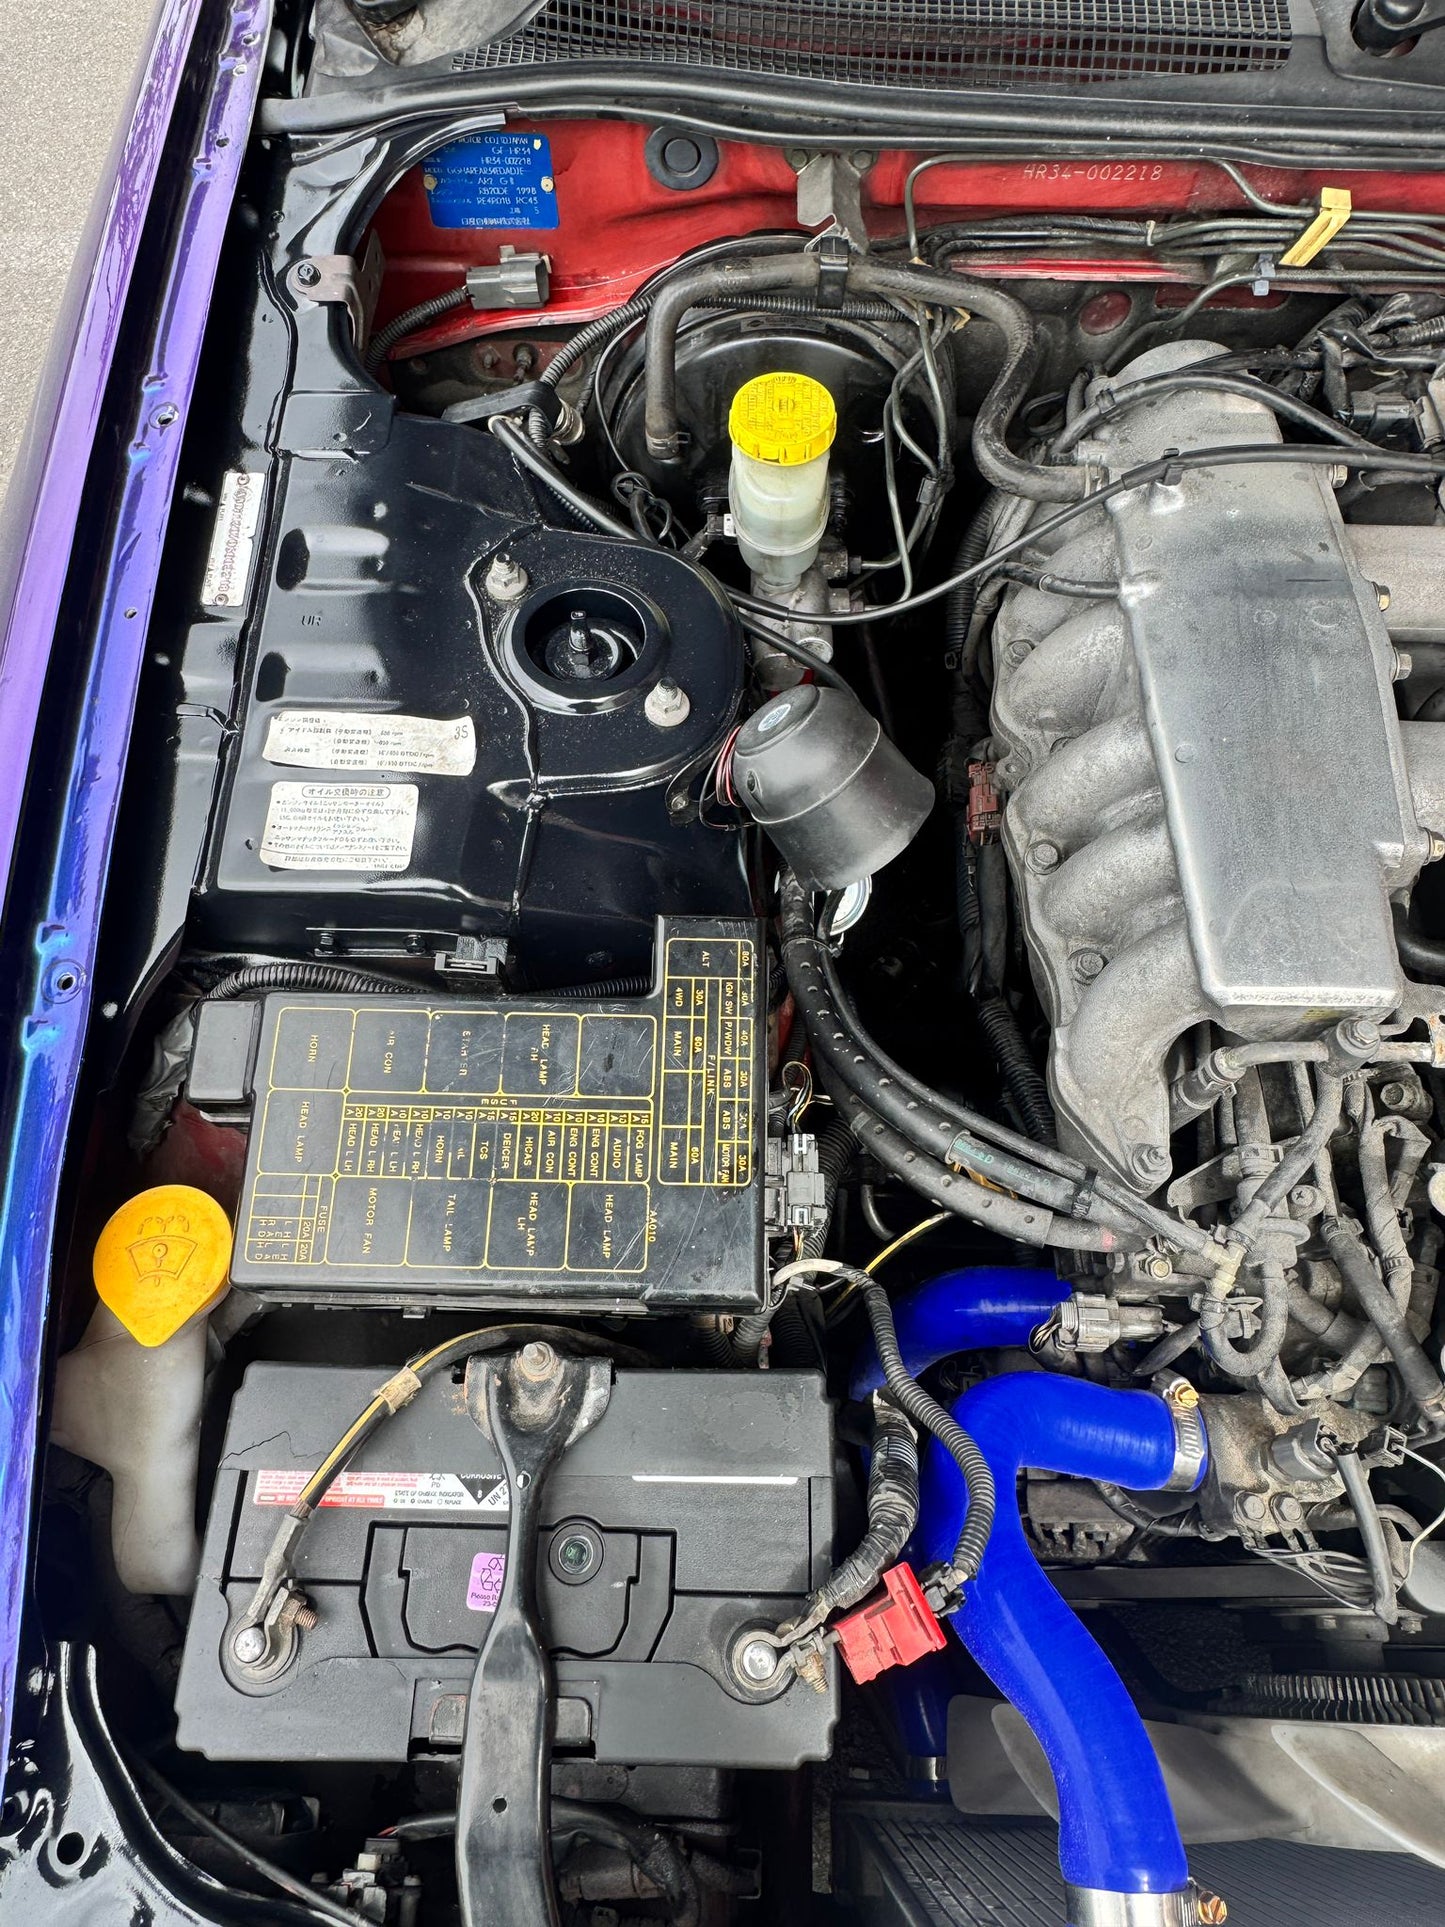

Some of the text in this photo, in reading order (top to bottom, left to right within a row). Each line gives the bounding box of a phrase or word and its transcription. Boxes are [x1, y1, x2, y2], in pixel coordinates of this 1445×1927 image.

[1024, 164, 1163, 181] HR34-002218
[308, 788, 385, 797] オイル交換時の注意
[702, 950, 710, 968] ALT
[742, 950, 750, 967] 80A
[675, 987, 684, 1007] 4WD
[695, 989, 704, 1006] 30A
[725, 982, 734, 1015] IGN SW
[673, 1031, 683, 1056] MAIN
[694, 1036, 703, 1053] 60A
[724, 1021, 733, 1055] P/WDW
[740, 1030, 749, 1047] 40A
[307, 1034, 319, 1063] HORN
[383, 1052, 394, 1074] CON
[538, 1058, 549, 1086] LAMP
[706, 1054, 716, 1095] F/LINK
[723, 1068, 732, 1088] ABS
[740, 1070, 748, 1088] 30A
[346, 1108, 355, 1116] A
[368, 1108, 377, 1117] A
[390, 1109, 399, 1117] A
[412, 1110, 421, 1118] A
[434, 1110, 443, 1118] A
[456, 1111, 465, 1119] A
[478, 1111, 487, 1119] A
[500, 1112, 509, 1120] A
[522, 1112, 531, 1120] A
[544, 1113, 553, 1121] A
[588, 1114, 597, 1122] A
[610, 1114, 619, 1122] A
[632, 1115, 641, 1123] A
[722, 1110, 731, 1130] ABS
[294, 1101, 311, 1163] HEAD LAMP
[347, 1123, 357, 1147] HEAD
[369, 1123, 380, 1147] HEAD
[434, 1135, 445, 1164] HORN
[479, 1140, 489, 1160] TCS
[501, 1133, 512, 1169] DEICER
[523, 1136, 534, 1166] HICAS
[544, 1130, 557, 1173] AIR CON
[567, 1127, 579, 1178] ENG CONT
[589, 1128, 601, 1178] ENG CONT
[612, 1137, 622, 1169] AUDIO
[634, 1129, 645, 1178] FOG LAMP
[669, 1142, 679, 1169] MAIN
[691, 1146, 700, 1165] 60A
[721, 1143, 731, 1167] MOTOR
[343, 1159, 353, 1172] LH
[366, 1159, 376, 1173] RH
[388, 1160, 399, 1173] LH
[411, 1161, 421, 1174] RH
[738, 1154, 747, 1172] 30A
[527, 1192, 539, 1222] HEAD
[317, 1205, 328, 1233] FUSE
[362, 1187, 378, 1255] MOTOR FAN
[442, 1193, 457, 1252] TAIL LAMP
[517, 1216, 527, 1231] LH
[602, 1194, 615, 1259] HEAD LAMP
[301, 1221, 311, 1239] 20A
[299, 1243, 309, 1261] 20A
[477, 1489, 483, 1499] 8
[487, 1491, 500, 1506] UN
